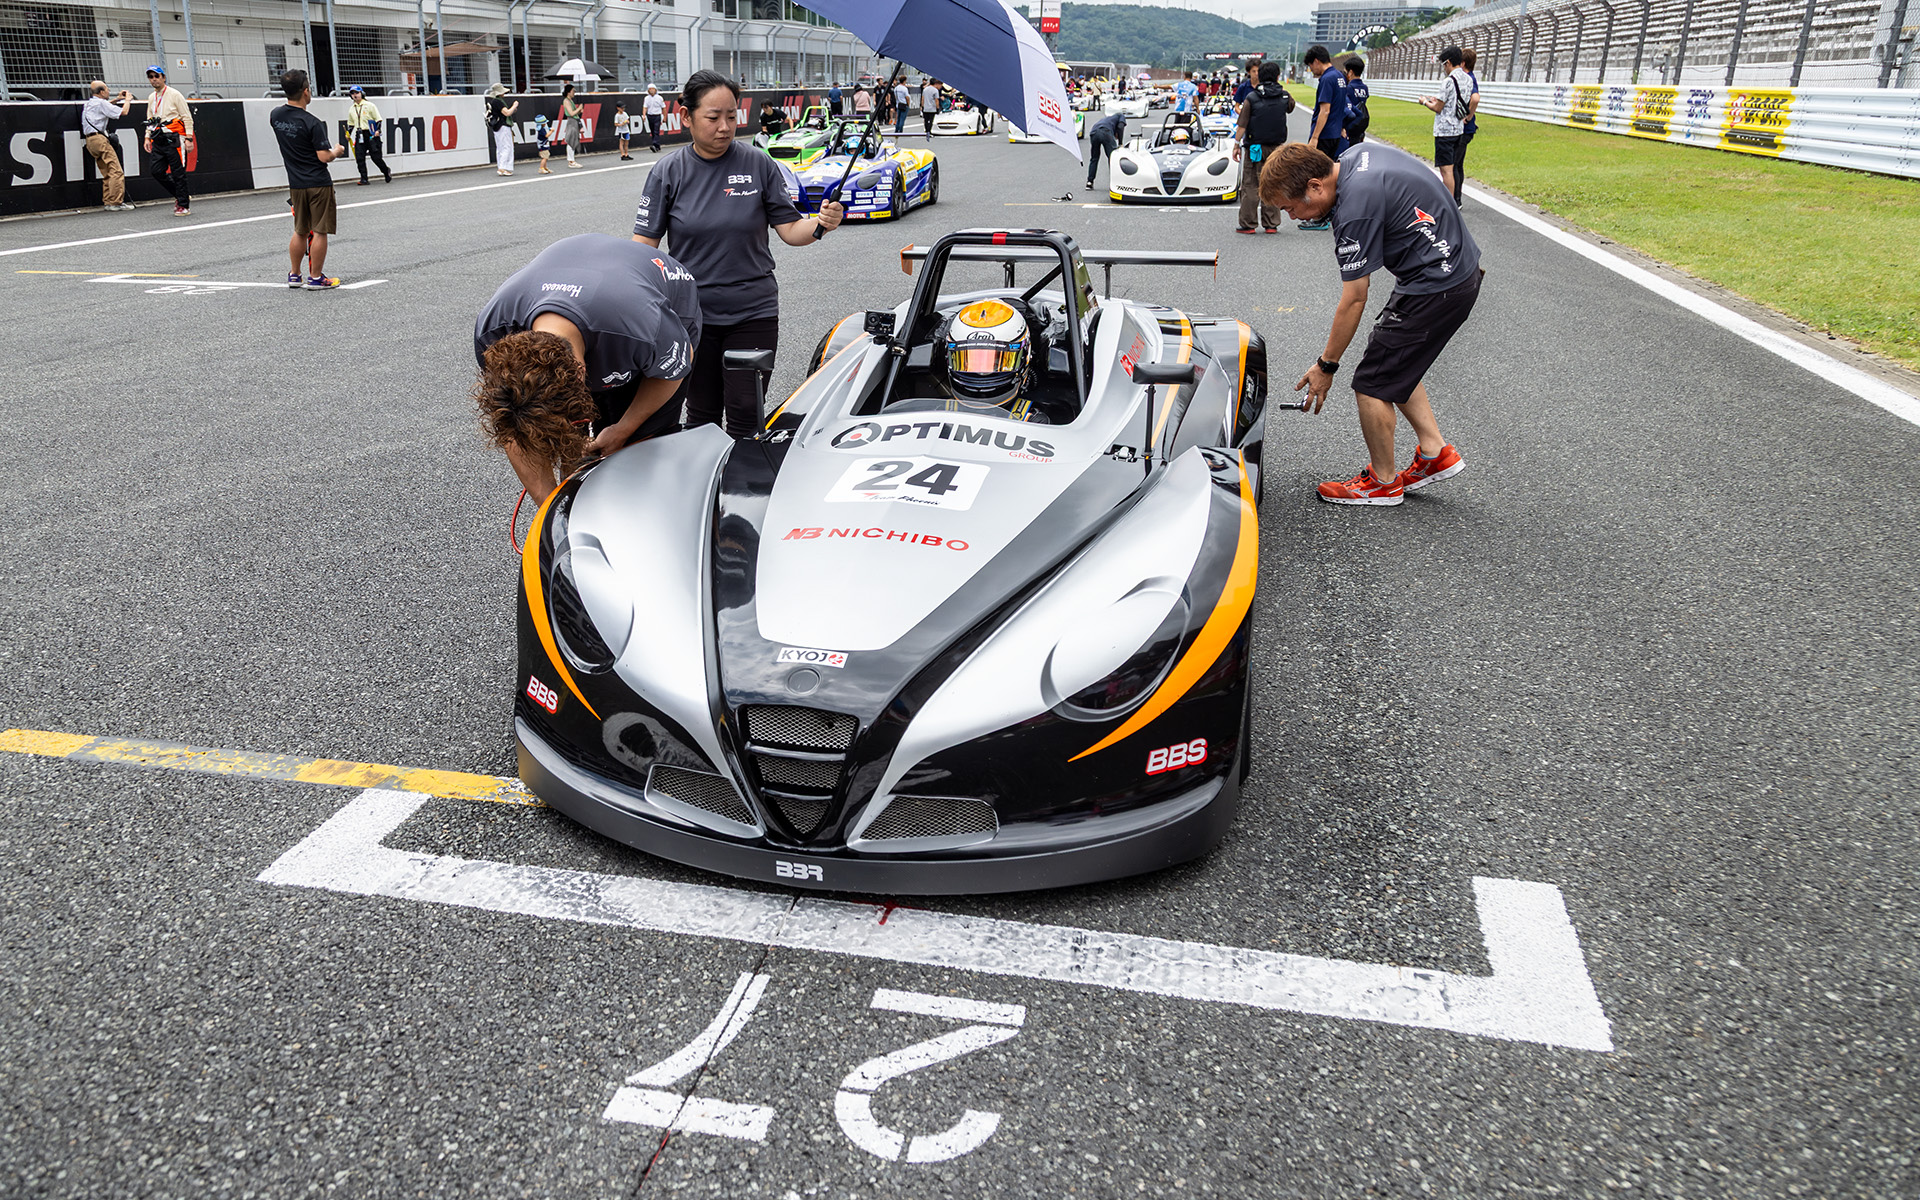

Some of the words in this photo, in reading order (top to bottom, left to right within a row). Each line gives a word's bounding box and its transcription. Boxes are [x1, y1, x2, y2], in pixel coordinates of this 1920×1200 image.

[1037, 91, 1062, 123] BBS
[1115, 184, 1142, 193] TRUST
[971, 332, 991, 340] Arai
[830, 421, 1056, 458] OPTIMUS
[1008, 451, 1053, 464] GROUP
[852, 460, 961, 496] 24
[827, 527, 970, 551] NICHIBO
[526, 675, 559, 714] BBS
[1145, 737, 1208, 776] BBS
[775, 860, 824, 882] BBR
[602, 972, 1027, 1164] 27
